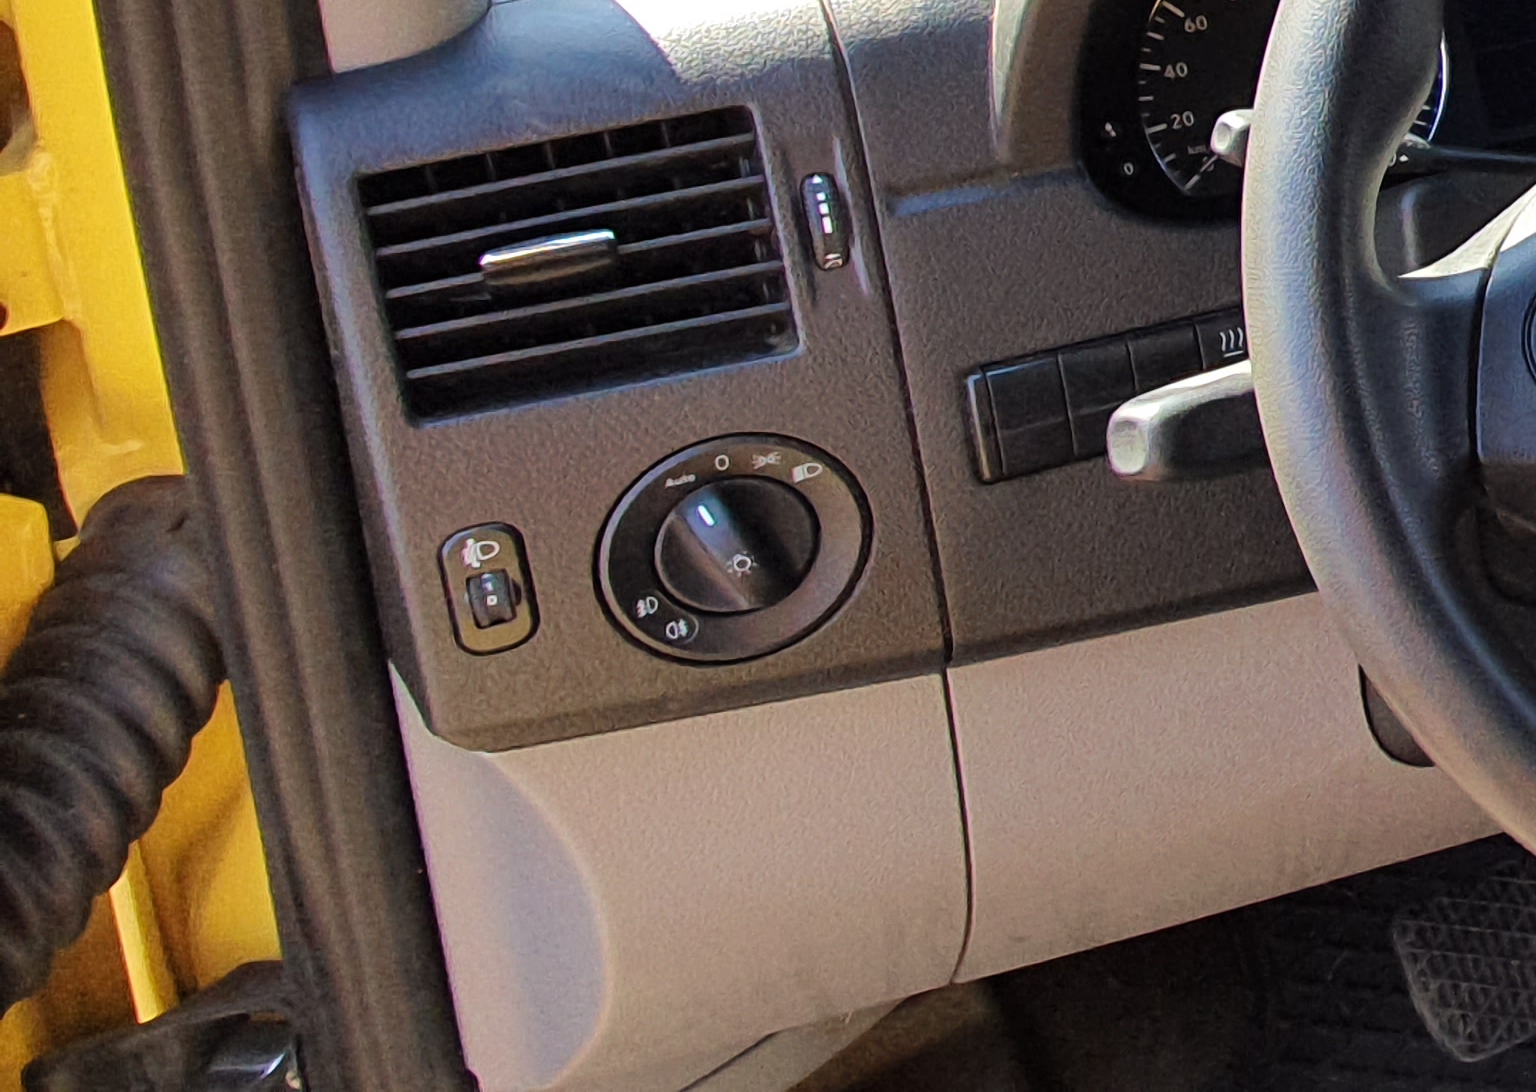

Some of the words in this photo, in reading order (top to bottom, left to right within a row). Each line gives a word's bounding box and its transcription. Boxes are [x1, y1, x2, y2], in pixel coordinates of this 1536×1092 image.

[1184, 15, 1208, 33] 60
[1164, 61, 1188, 80] 40
[1170, 110, 1194, 130] 20
[714, 454, 729, 471] 0
[665, 474, 695, 488] Auto
